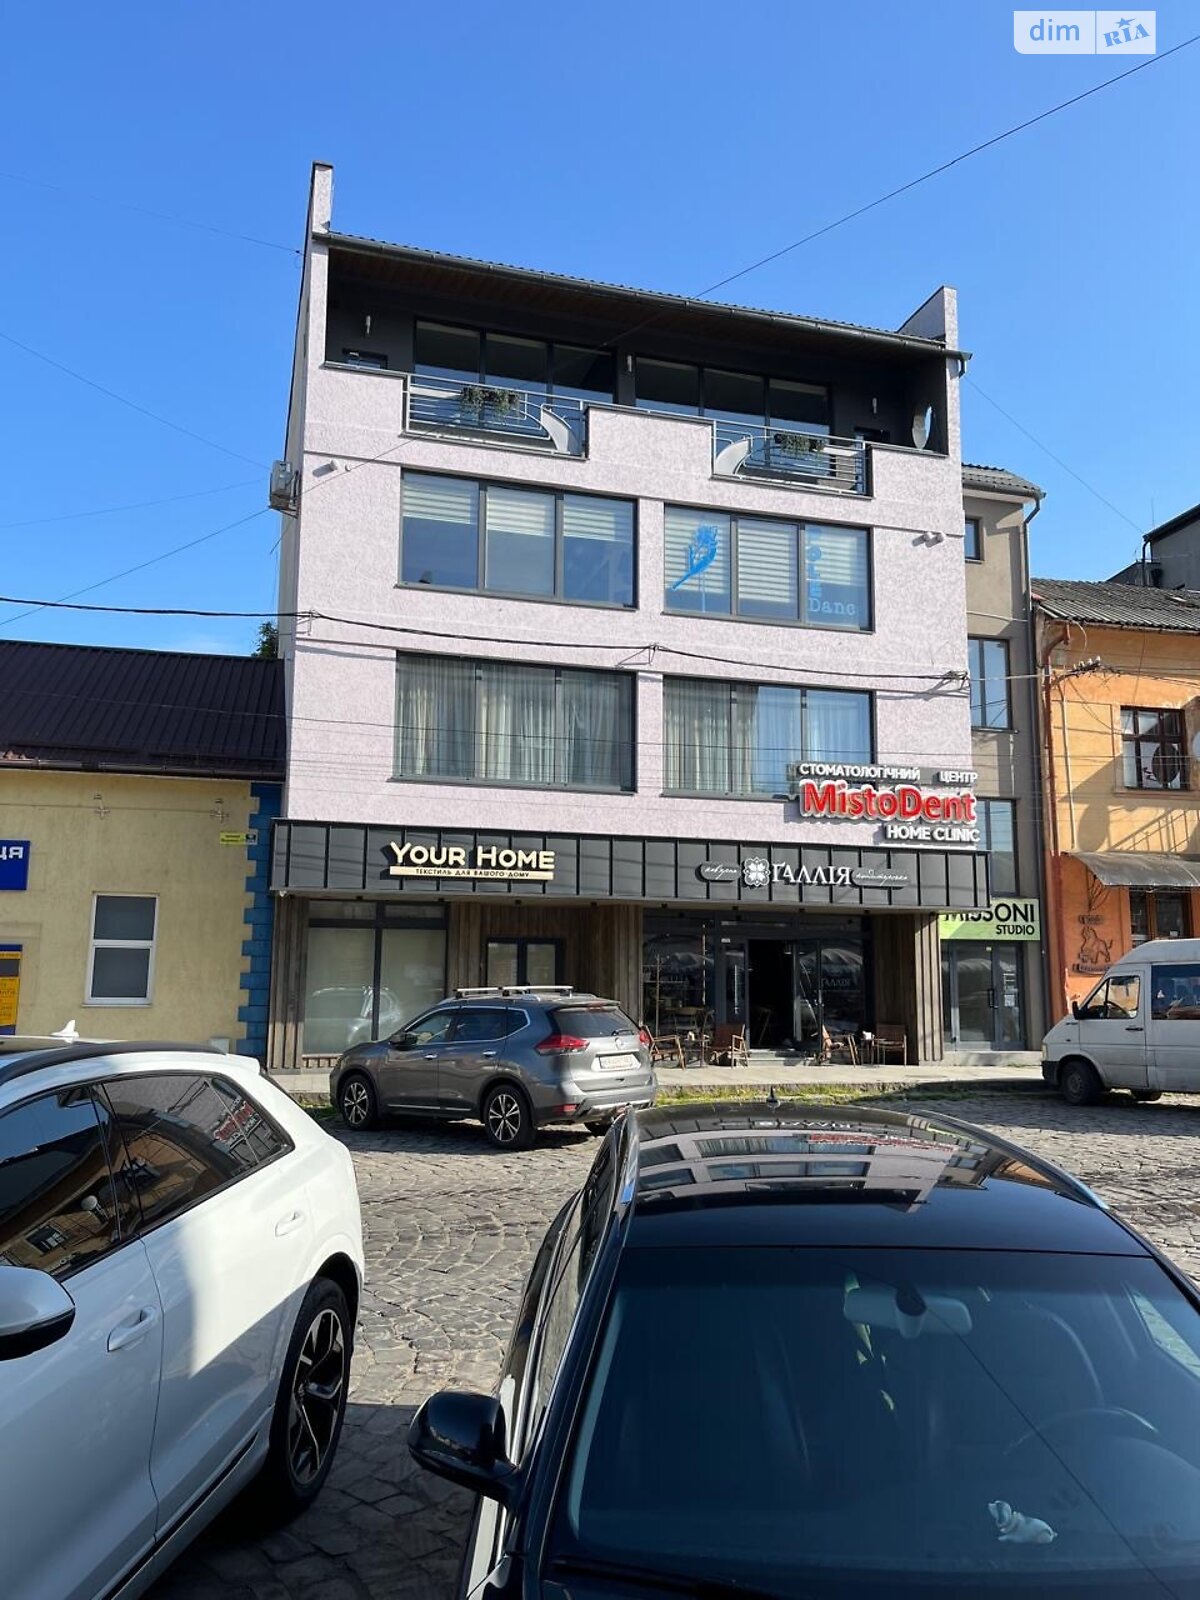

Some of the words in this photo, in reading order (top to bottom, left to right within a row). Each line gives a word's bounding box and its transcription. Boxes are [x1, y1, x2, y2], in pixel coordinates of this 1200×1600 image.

[800, 763, 920, 781] СТОМАТОЛОГІЧНИЙ
[940, 770, 978, 784] ЦЕНТР
[801, 780, 977, 822] MistoDent
[887, 824, 931, 840] HOME
[933, 826, 980, 842] CLINIC
[390, 841, 466, 866] YOUR
[477, 845, 556, 870] HOME
[416, 868, 452, 876] ТЕКСТИЛЬ
[996, 924, 1035, 936] STUDIO
